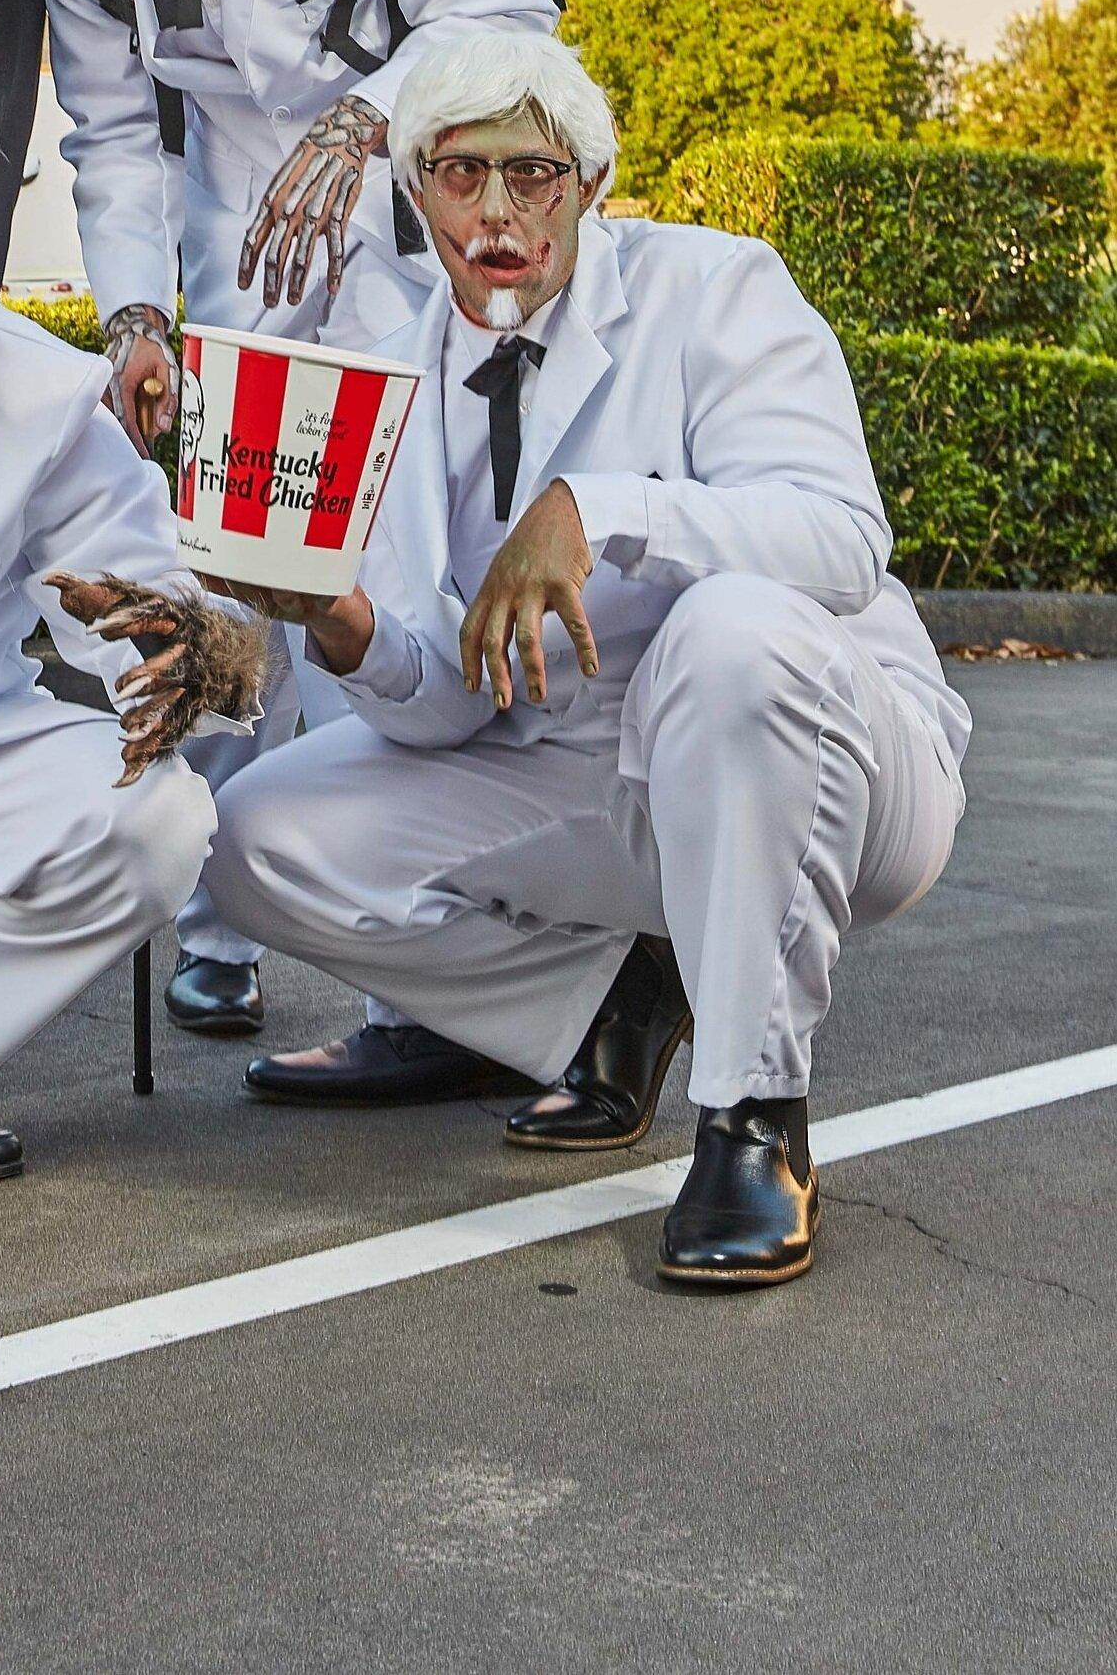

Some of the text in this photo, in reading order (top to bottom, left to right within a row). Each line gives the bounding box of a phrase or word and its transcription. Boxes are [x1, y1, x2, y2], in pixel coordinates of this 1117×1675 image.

[199, 457, 351, 515] Fried Chicken
[221, 433, 339, 488] Kentucky
